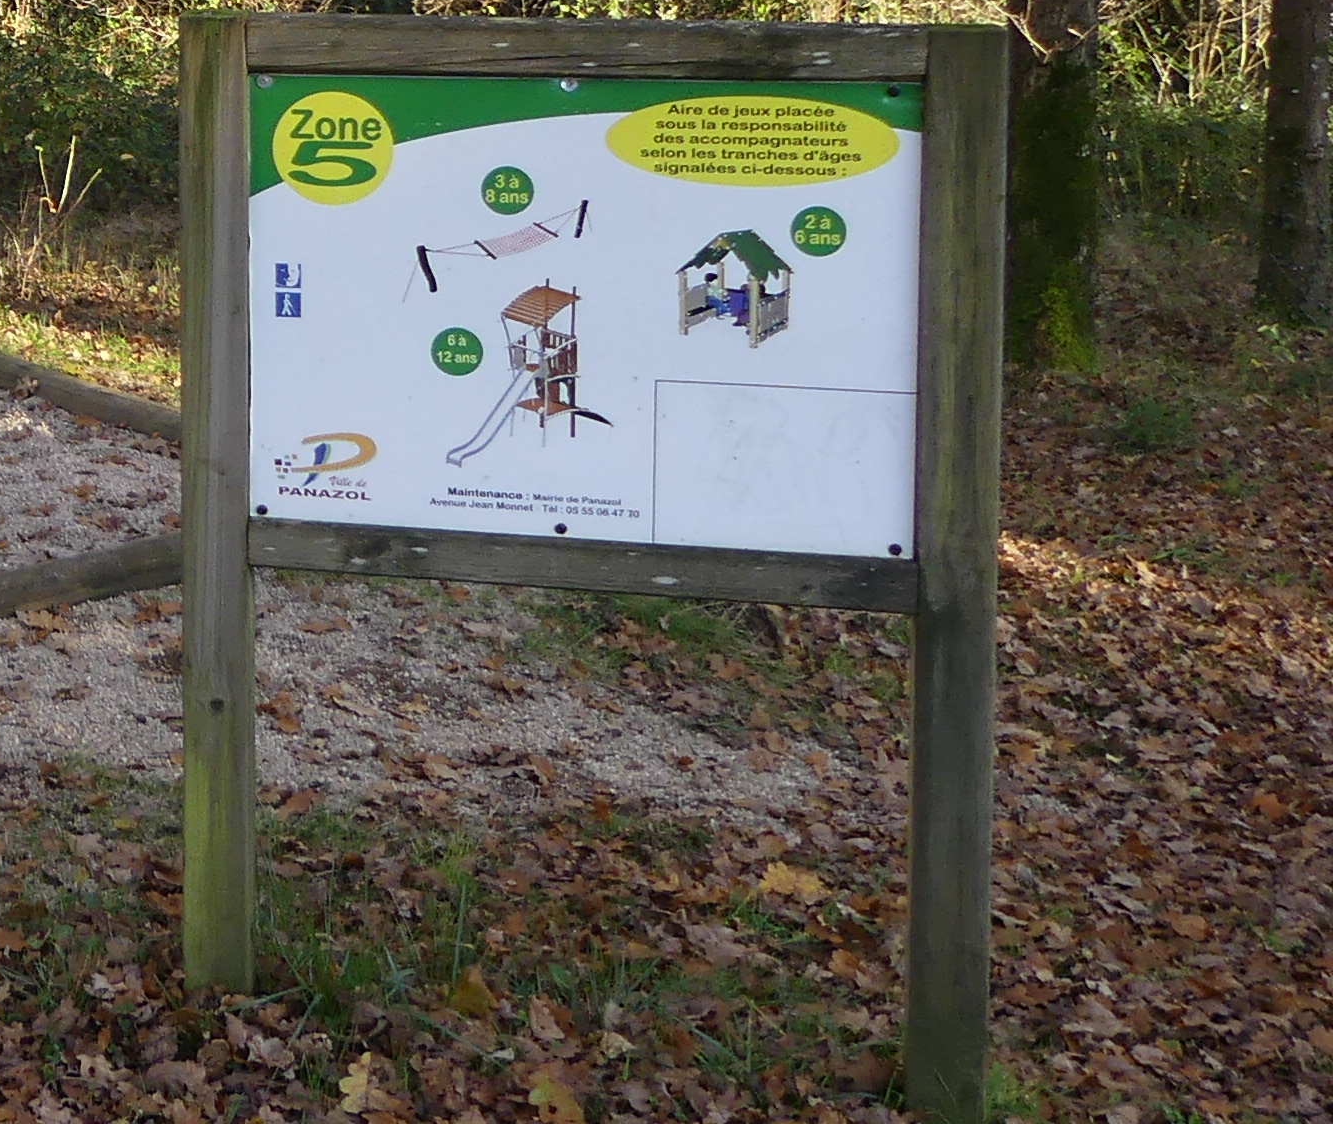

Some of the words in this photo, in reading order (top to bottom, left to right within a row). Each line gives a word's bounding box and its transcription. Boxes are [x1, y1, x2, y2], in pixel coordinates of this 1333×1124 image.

[667, 104, 703, 116] Aire
[707, 105, 729, 116] de
[733, 105, 770, 118] jeux
[775, 105, 835, 118] placée
[290, 108, 381, 140] Zone
[655, 120, 696, 130] sous
[701, 119, 716, 130] la
[721, 119, 847, 133] responsabilité
[653, 133, 685, 144] des
[689, 135, 849, 148] accompagnateurs
[640, 147, 687, 158] selon
[691, 148, 717, 159] les
[721, 149, 798, 161] tranches
[803, 150, 862, 164] d'âges
[287, 141, 377, 187] 5
[653, 162, 737, 175] signalées
[741, 163, 837, 176] ci-dessous
[494, 173, 505, 189] 3
[508, 174, 520, 189] à
[485, 188, 496, 203] 8
[499, 192, 529, 204] ans
[804, 214, 817, 229] 2
[819, 214, 832, 230] à
[794, 229, 805, 244] 6
[809, 233, 841, 245] ans
[447, 334, 456, 347] 6
[458, 335, 467, 347] à
[436, 351, 452, 363] 12
[454, 353, 478, 364] ans
[278, 487, 372, 501] PANAZOL
[447, 486, 523, 500] Maintenance
[533, 493, 564, 502] Mairie
[566, 495, 579, 504] de
[582, 496, 622, 506] Panazol
[430, 497, 467, 507] Avenue
[468, 500, 493, 509] Jean
[496, 501, 534, 512] Monnet
[611, 508, 624, 517] 47
